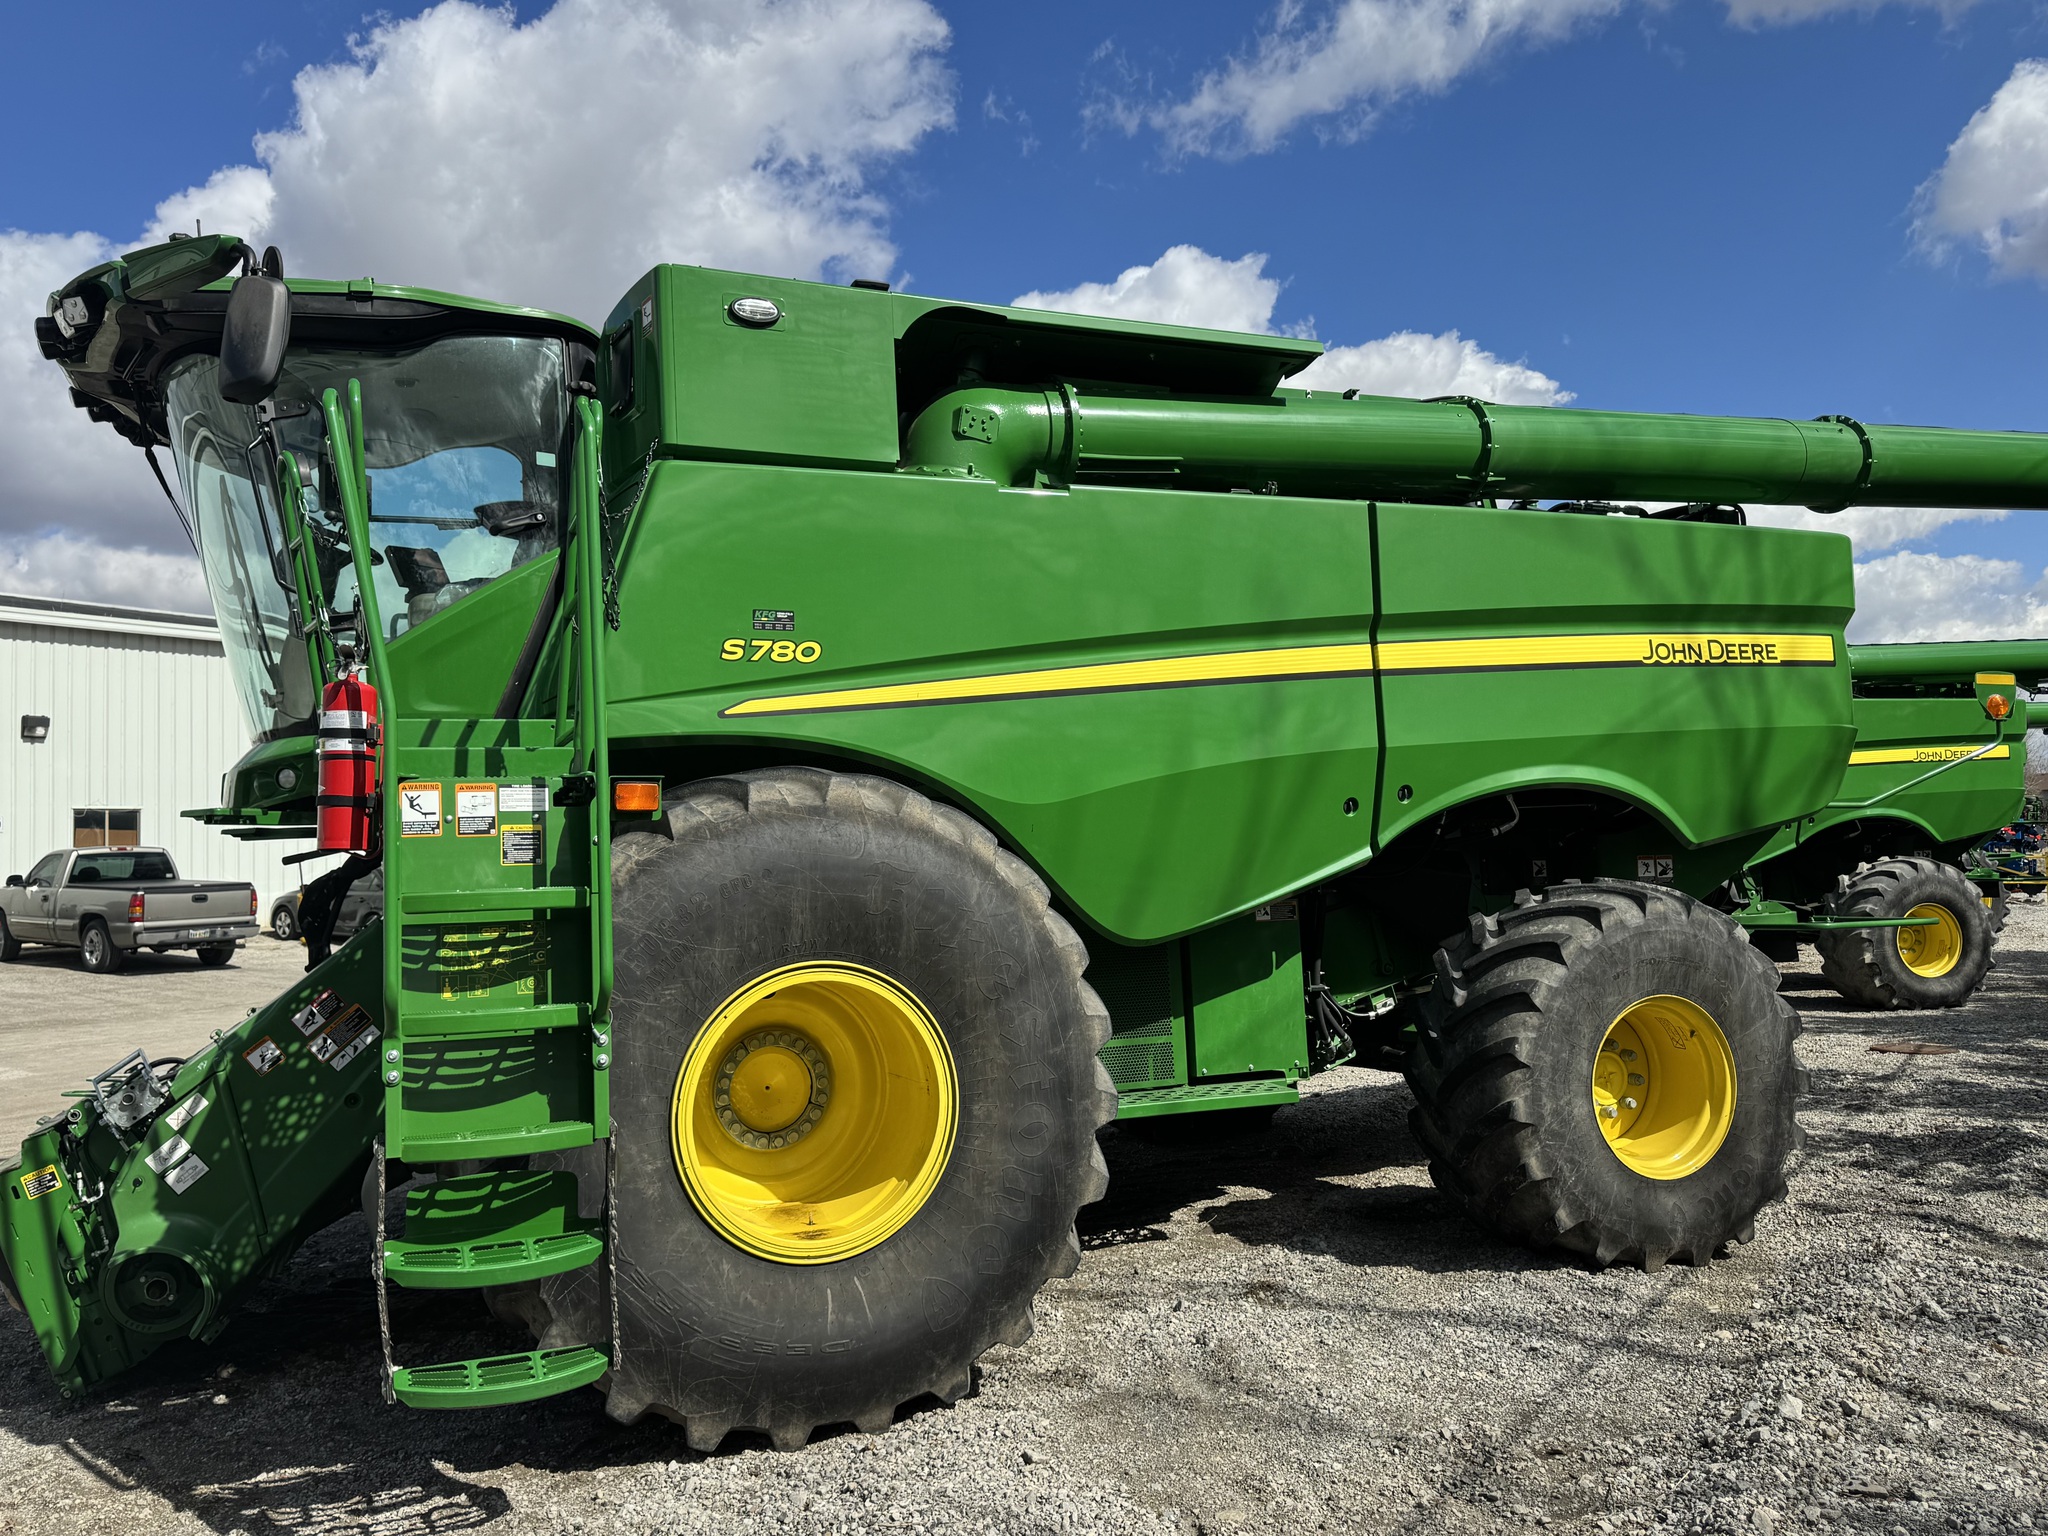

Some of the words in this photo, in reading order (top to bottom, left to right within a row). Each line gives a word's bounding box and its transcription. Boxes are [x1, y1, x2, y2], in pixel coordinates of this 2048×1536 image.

[754, 610, 776, 618] KFG
[720, 637, 822, 664] S780
[1642, 638, 1702, 661] JOHN
[1707, 639, 1779, 661] DEERE
[1913, 749, 1943, 761] JOHN
[1944, 748, 1979, 760] DEE
[407, 783, 440, 791] WARNING
[26, 1166, 54, 1180] CAUTION
